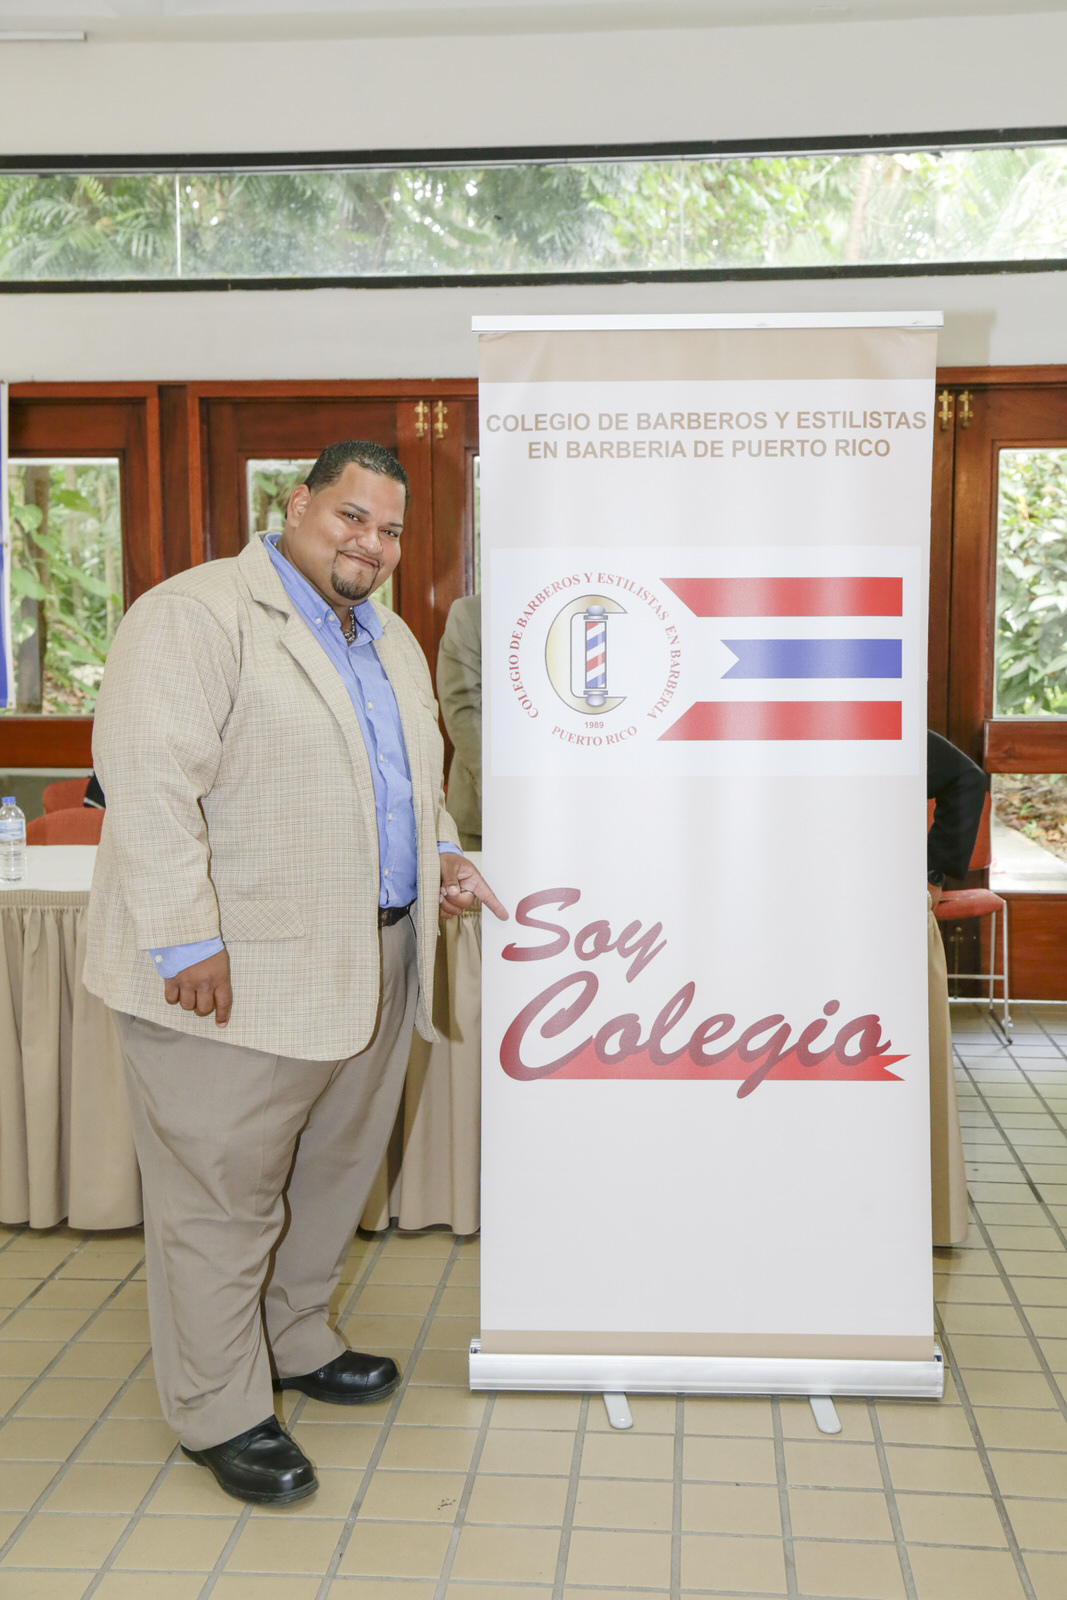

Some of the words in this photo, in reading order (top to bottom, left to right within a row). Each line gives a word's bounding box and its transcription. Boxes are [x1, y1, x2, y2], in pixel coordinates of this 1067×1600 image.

[486, 413, 591, 432] COLEGIO
[599, 412, 629, 431] DE
[636, 411, 768, 431] BARBEROS
[774, 411, 789, 430] Y
[797, 410, 927, 430] ESTILISTAS
[528, 441, 558, 459] EN
[566, 440, 685, 459] BARBERIA
[694, 439, 724, 458] DE
[732, 439, 827, 458] PUERTO
[835, 438, 890, 458] RICO
[584, 572, 593, 583] Y
[516, 574, 581, 629] BARBEROS
[597, 572, 669, 621] ESTILISTAS
[509, 630, 523, 650] DE
[665, 625, 680, 645] EN
[508, 654, 539, 719] COLEGIO
[647, 649, 681, 720] BARBERIA
[551, 725, 603, 747] PUERTO
[606, 725, 638, 745] RICO
[584, 721, 605, 729] 1989
[501, 887, 667, 983] Soy
[500, 970, 892, 1099] Colegio
